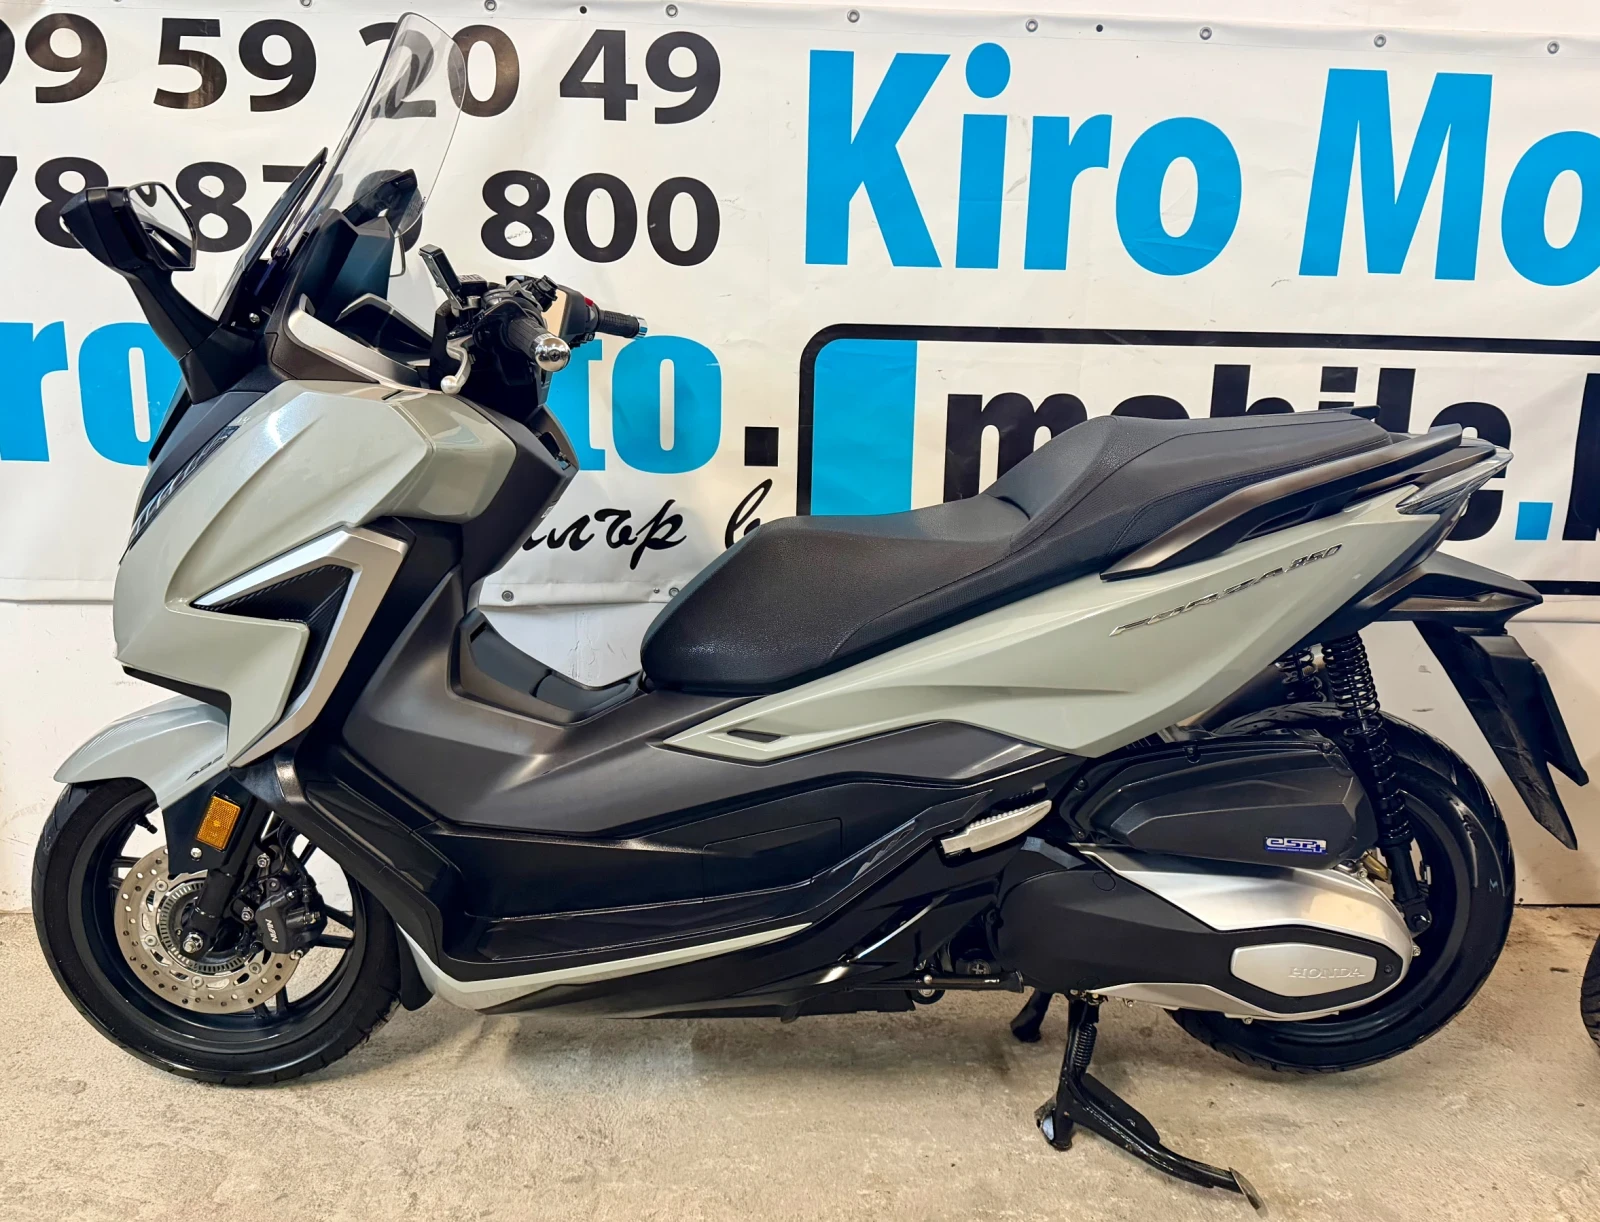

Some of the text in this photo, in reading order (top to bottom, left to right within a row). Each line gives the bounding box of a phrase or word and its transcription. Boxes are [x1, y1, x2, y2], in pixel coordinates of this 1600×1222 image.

[0, 13, 721, 124] 9 59 20 49
[0, 156, 109, 249] 8
[480, 170, 721, 266] 800
[805, 43, 1600, 285] Kiro Mo
[1285, 543, 1343, 573] 350
[1287, 966, 1366, 979] HONDA
